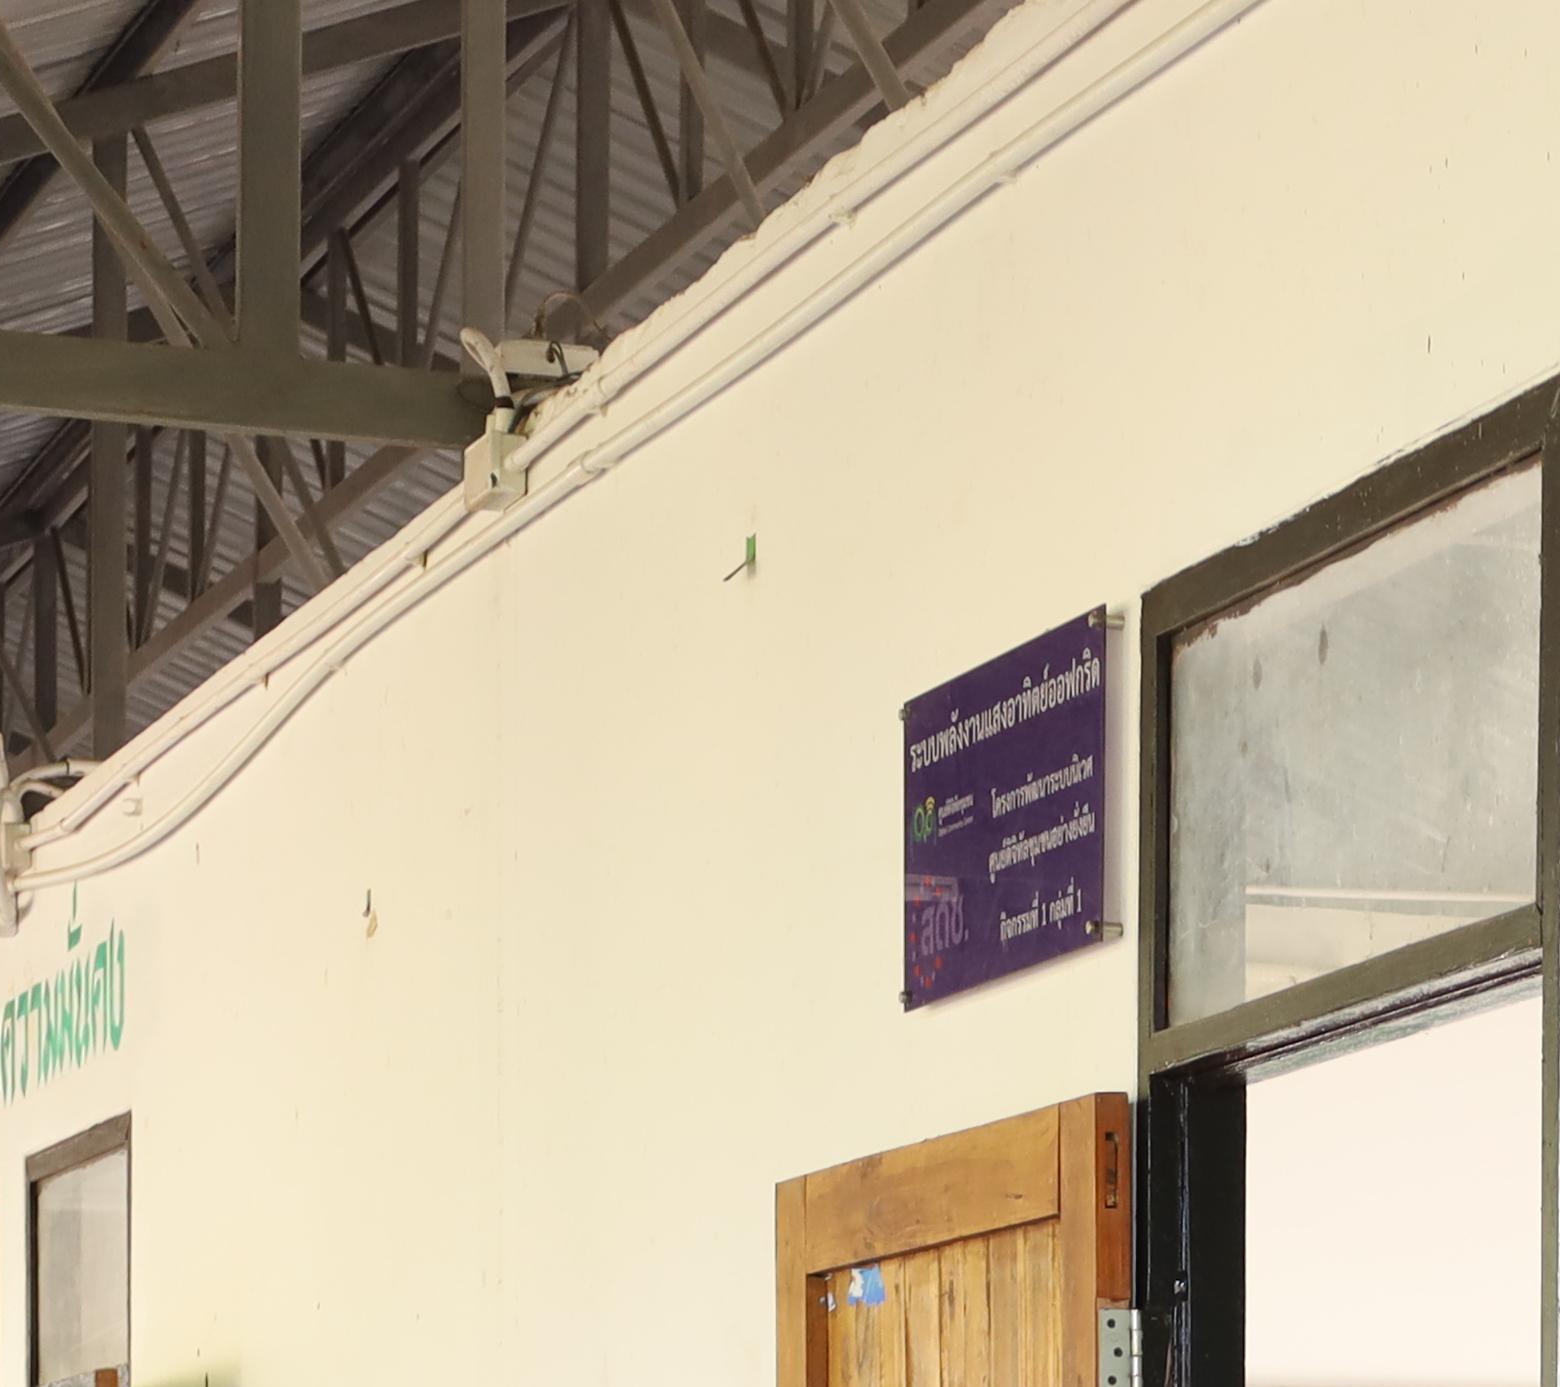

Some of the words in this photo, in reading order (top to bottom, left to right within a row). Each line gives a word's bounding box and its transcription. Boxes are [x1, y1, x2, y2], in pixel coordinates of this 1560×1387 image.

[910, 647, 1100, 773] ระบบพลังงานแสงอาทิตย์ออฟกริด
